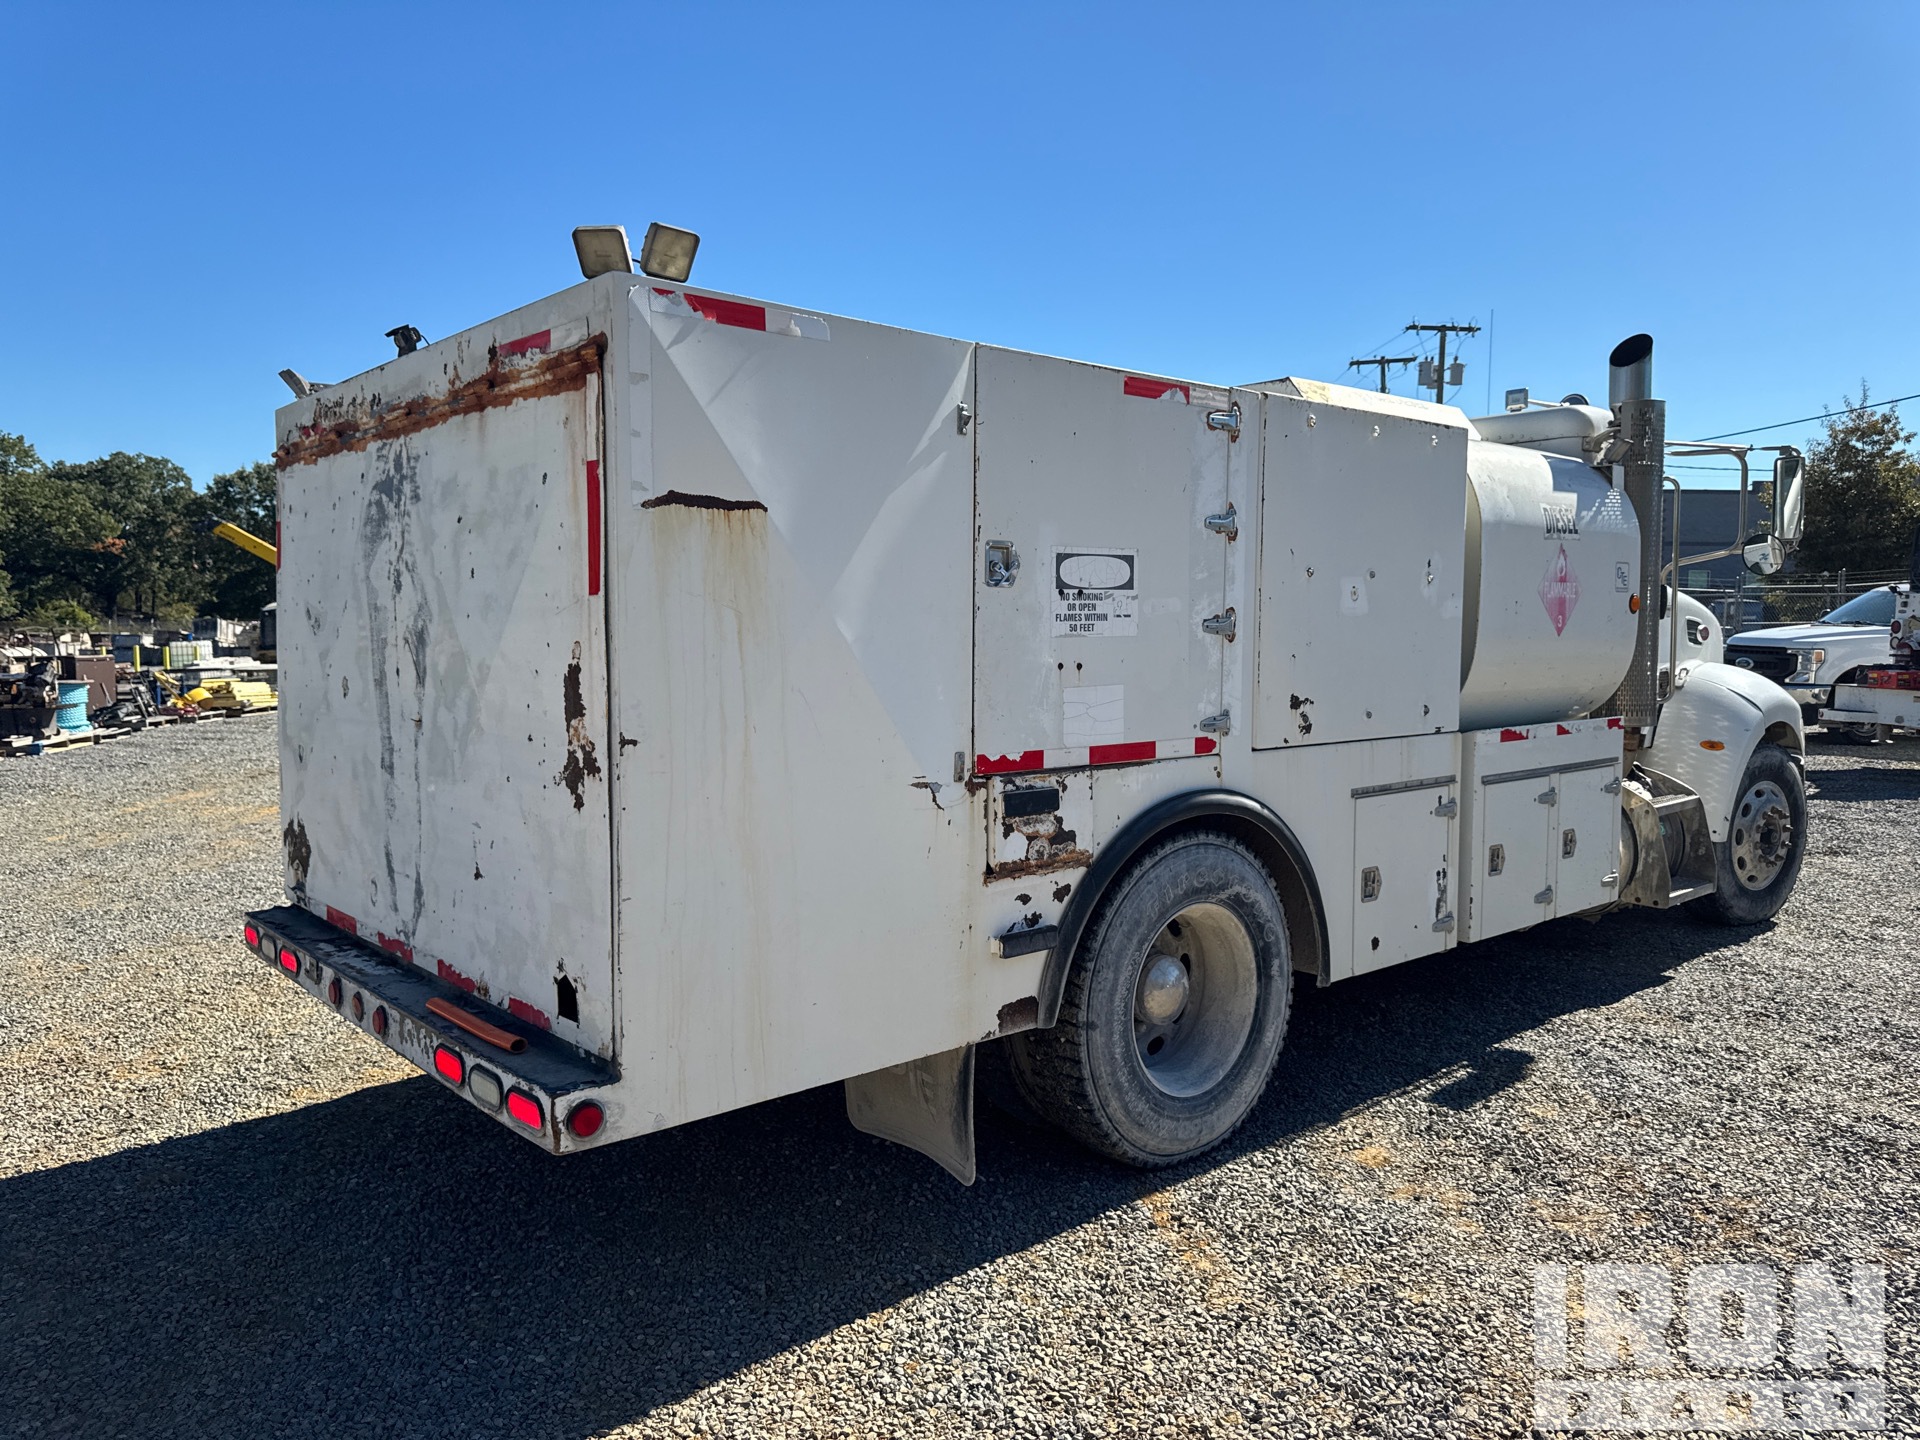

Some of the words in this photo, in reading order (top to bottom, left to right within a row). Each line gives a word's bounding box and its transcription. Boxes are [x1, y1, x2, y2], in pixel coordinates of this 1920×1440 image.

[1542, 506, 1579, 535] DIESEL
[1060, 593, 1070, 601] NO
[1072, 592, 1103, 601] SMOKING
[1067, 603, 1076, 611] OR
[1078, 603, 1096, 611] OPEN
[1055, 613, 1082, 622] FLAMES
[1084, 613, 1108, 622] WITHIN
[1557, 615, 1562, 627] 3
[1069, 623, 1078, 632] 50
[1079, 623, 1095, 632] FEET
